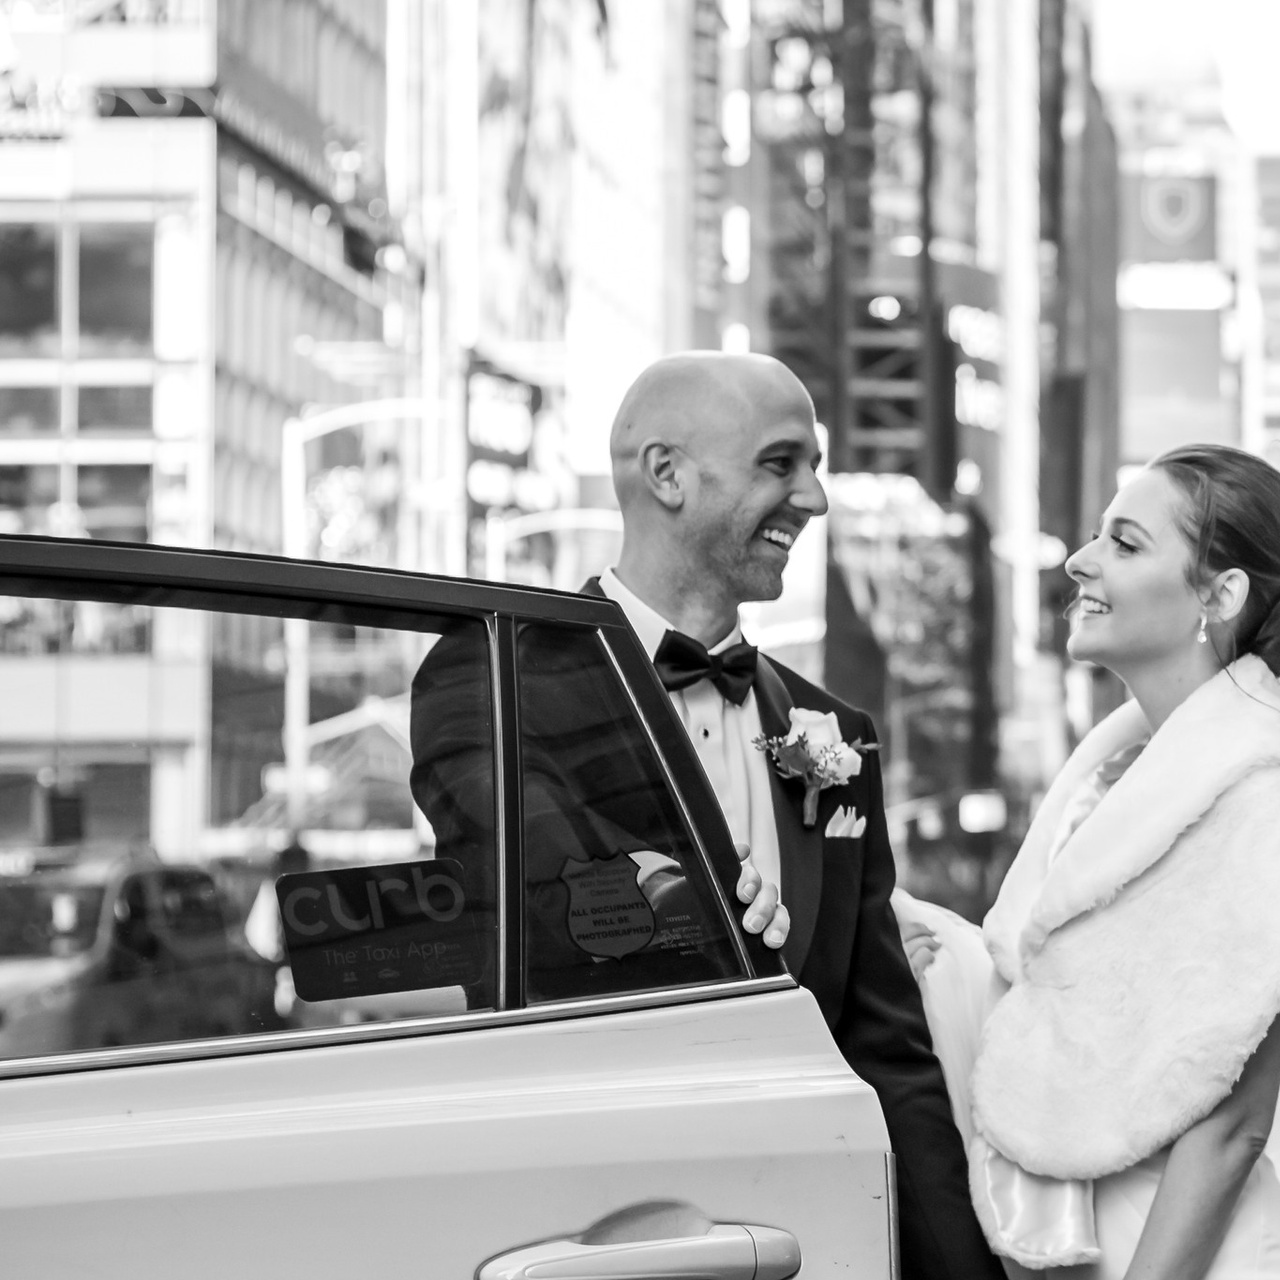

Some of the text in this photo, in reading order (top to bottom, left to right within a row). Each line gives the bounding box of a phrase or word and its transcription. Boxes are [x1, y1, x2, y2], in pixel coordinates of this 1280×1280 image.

[284, 867, 466, 937] curb
[571, 901, 647, 918] ALL OCCUPANTS
[592, 915, 631, 927] WILL BE
[665, 914, 691, 923] TOYOTA
[576, 925, 652, 941] PHOTOGRAPHED
[323, 941, 447, 966] The Taxi App
